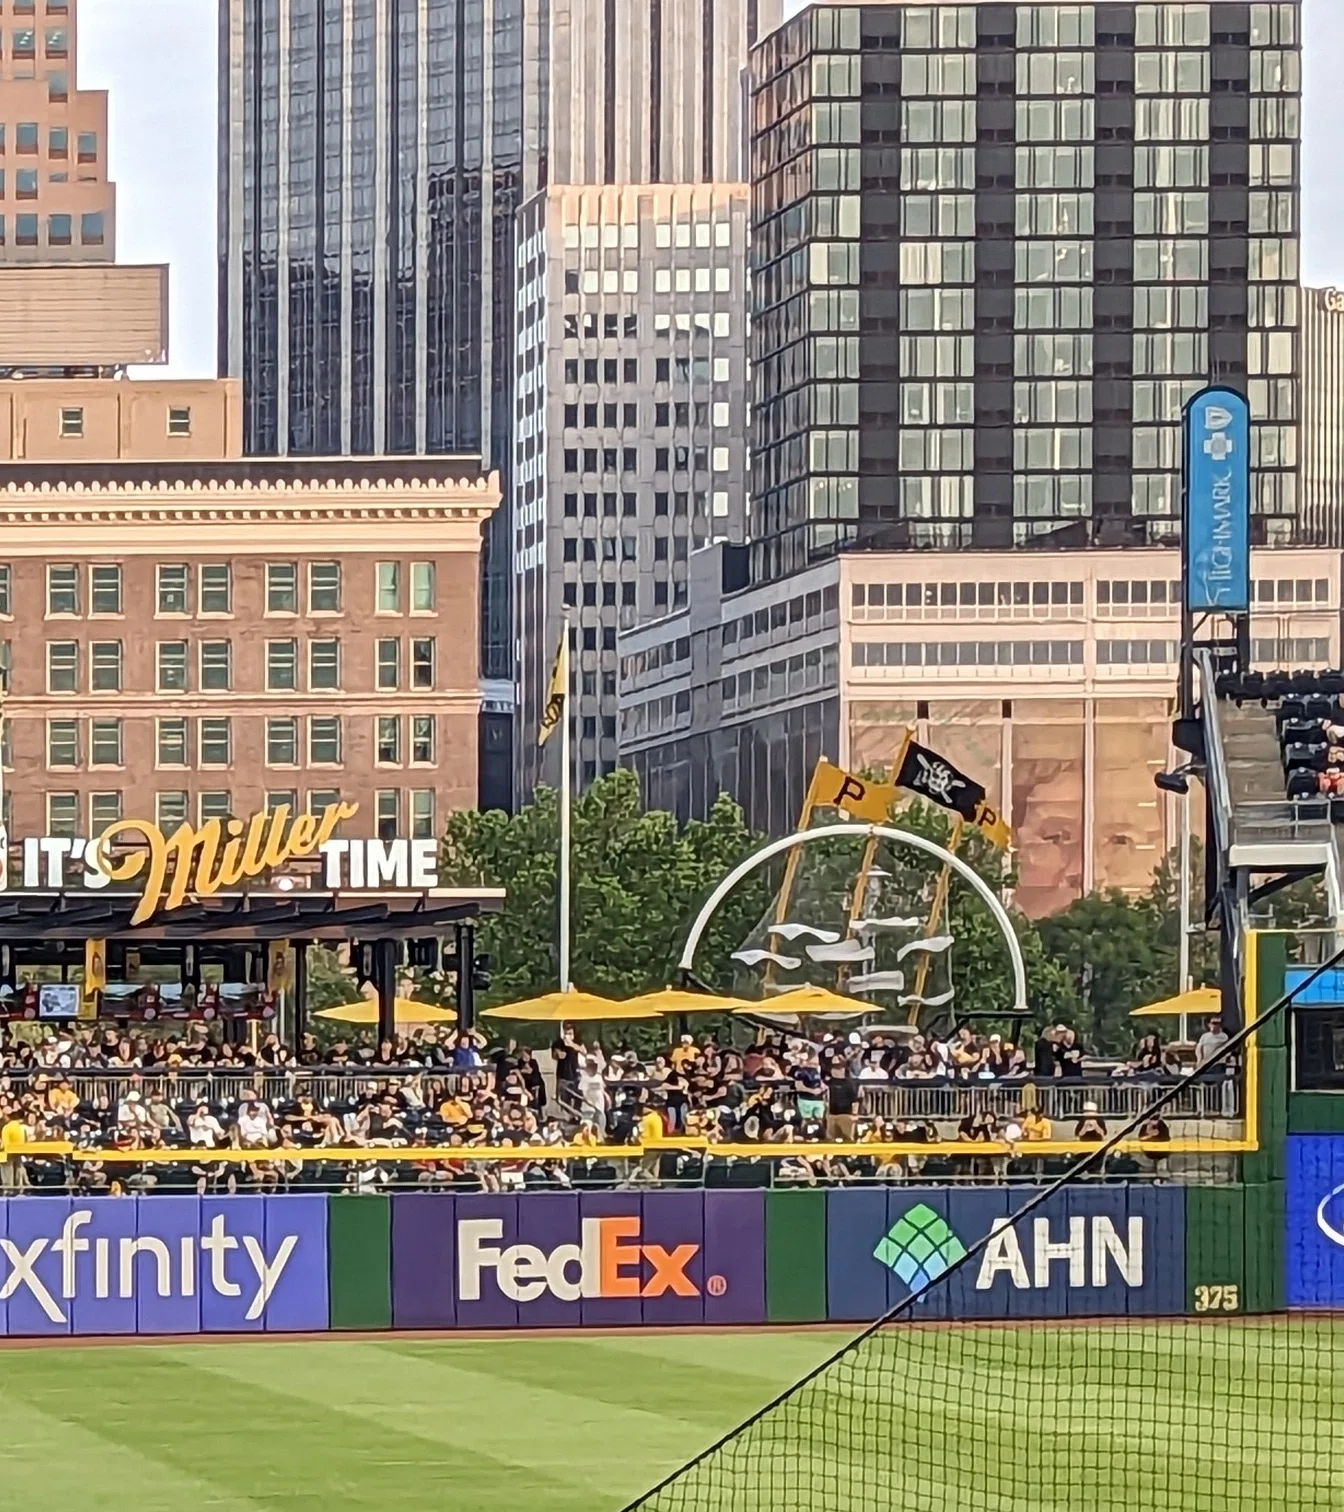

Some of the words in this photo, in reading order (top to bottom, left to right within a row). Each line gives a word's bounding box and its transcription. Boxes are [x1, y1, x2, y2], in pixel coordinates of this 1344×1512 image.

[833, 776, 865, 805] P
[978, 807, 997, 826] P
[24, 838, 111, 889] IT'S
[97, 801, 360, 925] Miller
[319, 838, 438, 888] TIME
[457, 1216, 700, 1301] FedEx
[976, 1216, 1144, 1289] AHN
[1194, 1284, 1238, 1311] 375
